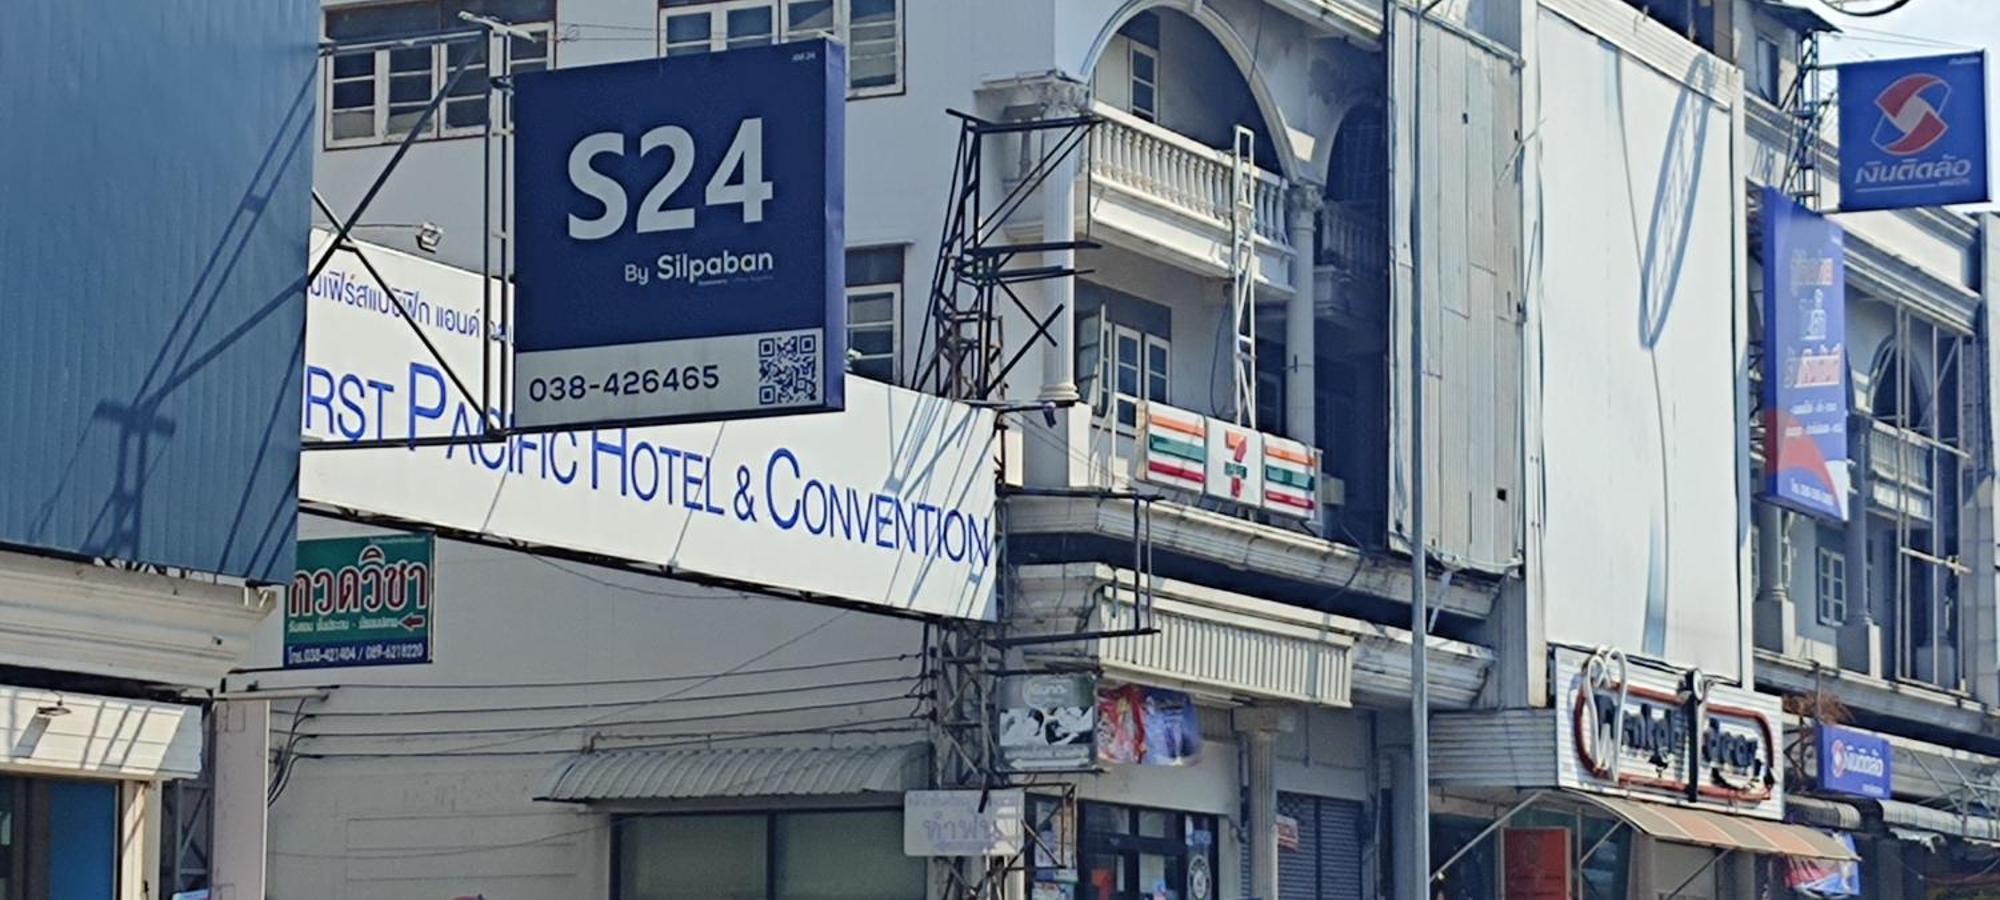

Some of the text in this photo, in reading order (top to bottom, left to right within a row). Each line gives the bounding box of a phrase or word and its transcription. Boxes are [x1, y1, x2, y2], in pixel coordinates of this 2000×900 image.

[568, 117, 774, 240] S24
[624, 264, 649, 285] By
[657, 250, 774, 283] Silpaban
[436, 308, 482, 338] แอนด์
[529, 365, 720, 402] 038-426465
[591, 427, 725, 515] HOTEL
[733, 464, 757, 522] &
[766, 447, 989, 567] CONVENTION
[288, 545, 428, 617] กวดวิชา
